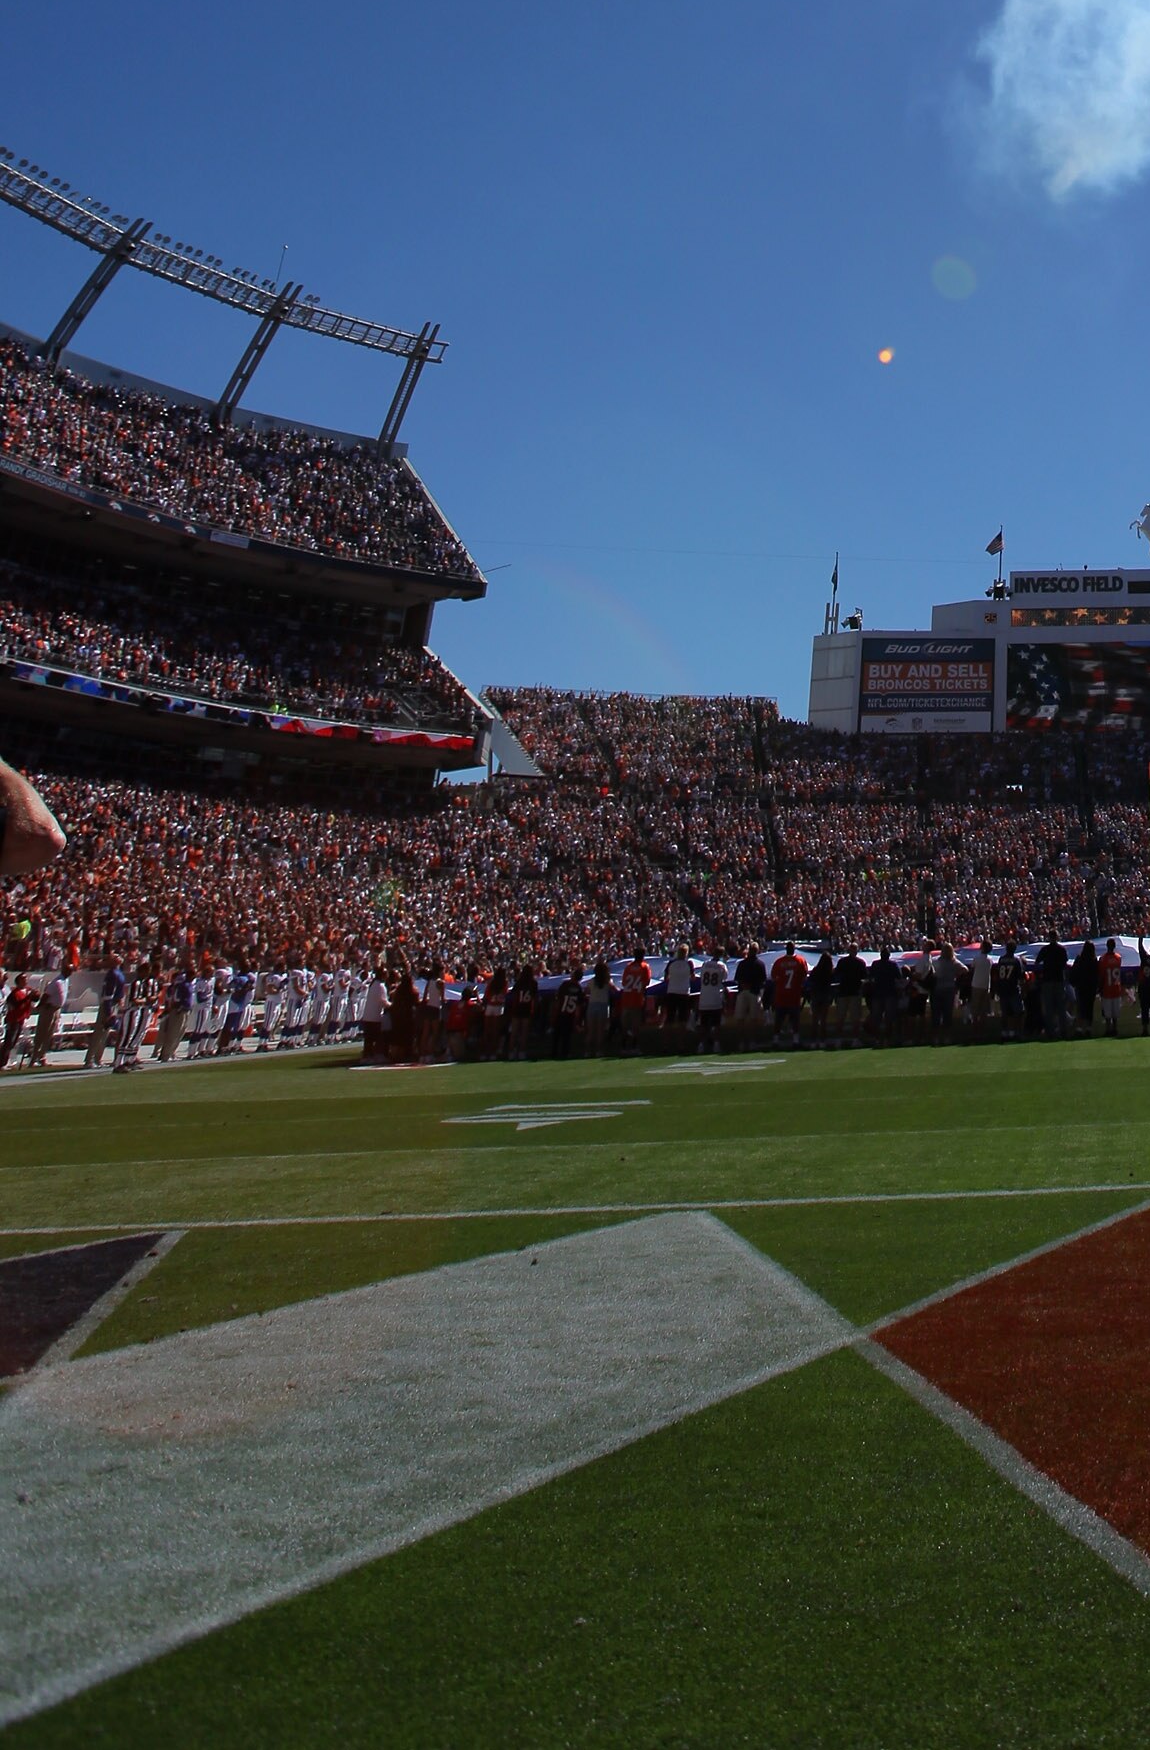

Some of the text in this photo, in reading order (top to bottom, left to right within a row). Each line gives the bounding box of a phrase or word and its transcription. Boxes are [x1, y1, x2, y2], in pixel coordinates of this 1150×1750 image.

[0, 459, 25, 475] RANDY
[25, 469, 67, 492] GRADISHAR
[1014, 576, 1123, 593] INVESCO FIELD
[885, 643, 974, 654] BUD LIGHT
[868, 664, 988, 678] BUY AND SELL
[868, 678, 988, 690] BRONCOS TICKETS
[867, 697, 987, 708] NFL.COM/TICKETEXCHANGE
[702, 972, 720, 986] 88
[785, 969, 794, 989] 7
[997, 965, 1012, 979] 87
[1105, 968, 1120, 986] 19
[624, 975, 642, 992] 24
[561, 995, 577, 1013] 15
